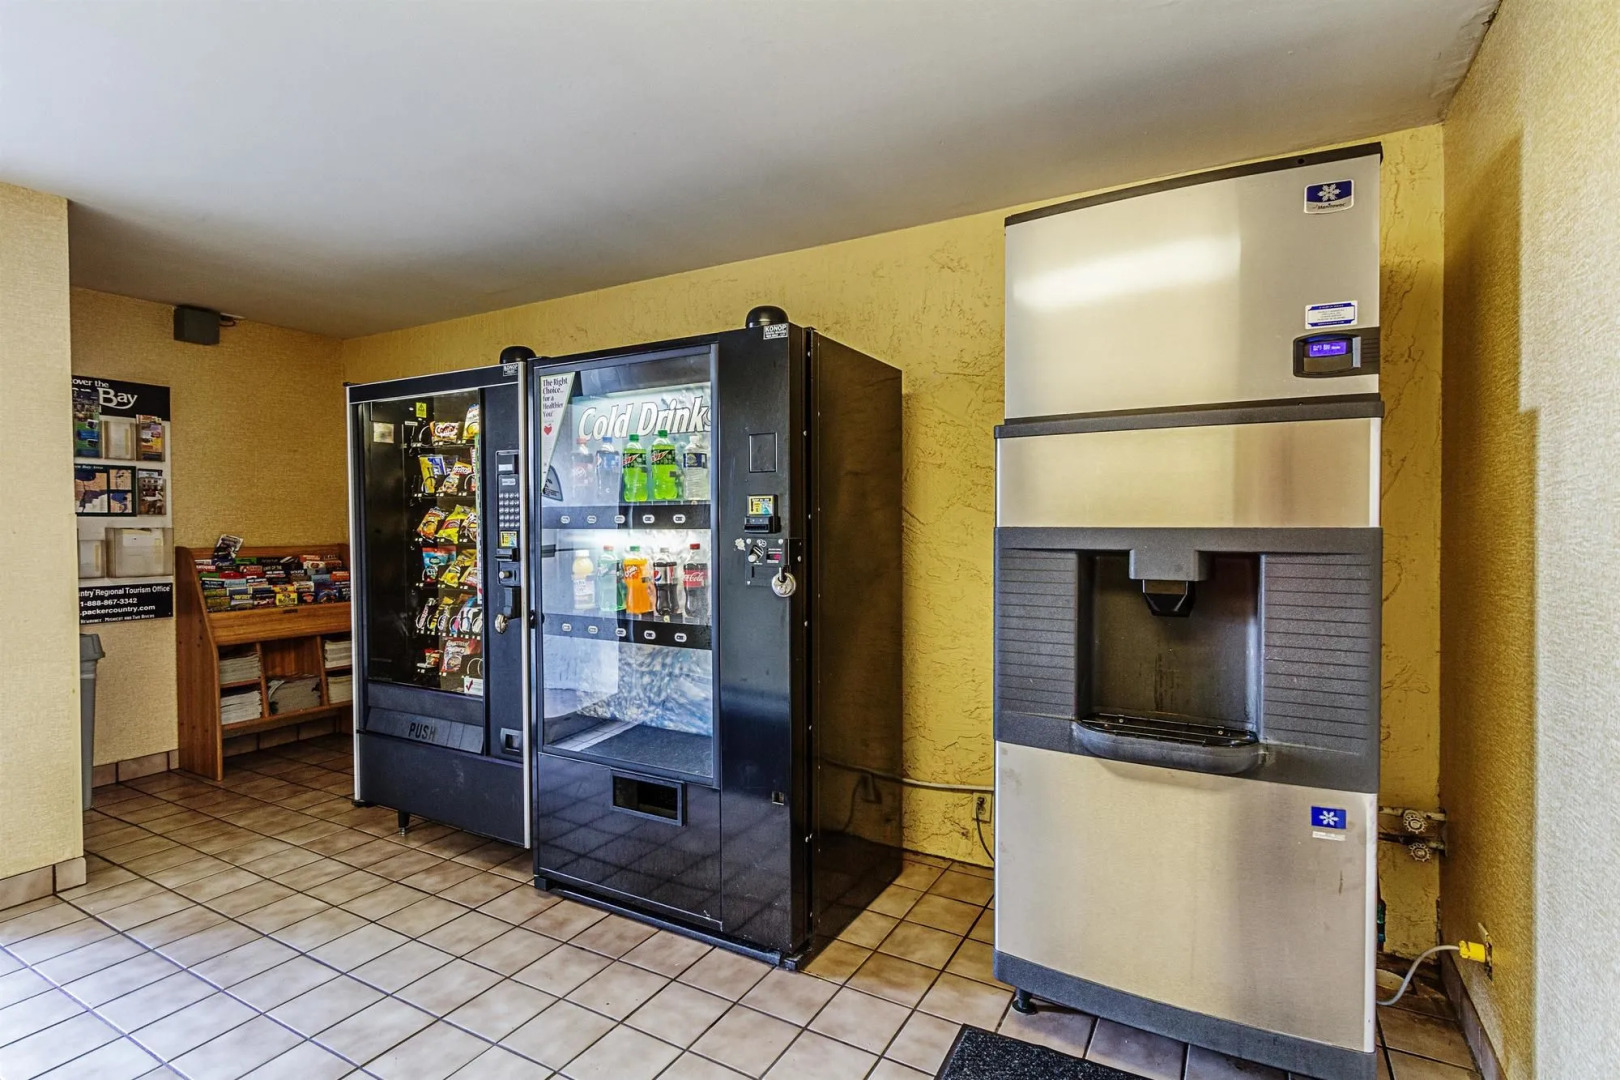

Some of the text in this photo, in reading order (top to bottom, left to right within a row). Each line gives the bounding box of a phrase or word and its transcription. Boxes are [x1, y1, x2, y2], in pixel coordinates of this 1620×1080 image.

[94, 380, 110, 388] the
[542, 377, 568, 387] The Right
[97, 387, 139, 410] Bay
[578, 403, 634, 440] Cold
[95, 588, 125, 597] Regional
[125, 587, 151, 595] Tourism
[152, 585, 171, 593] Office
[408, 722, 436, 742] PUSH
